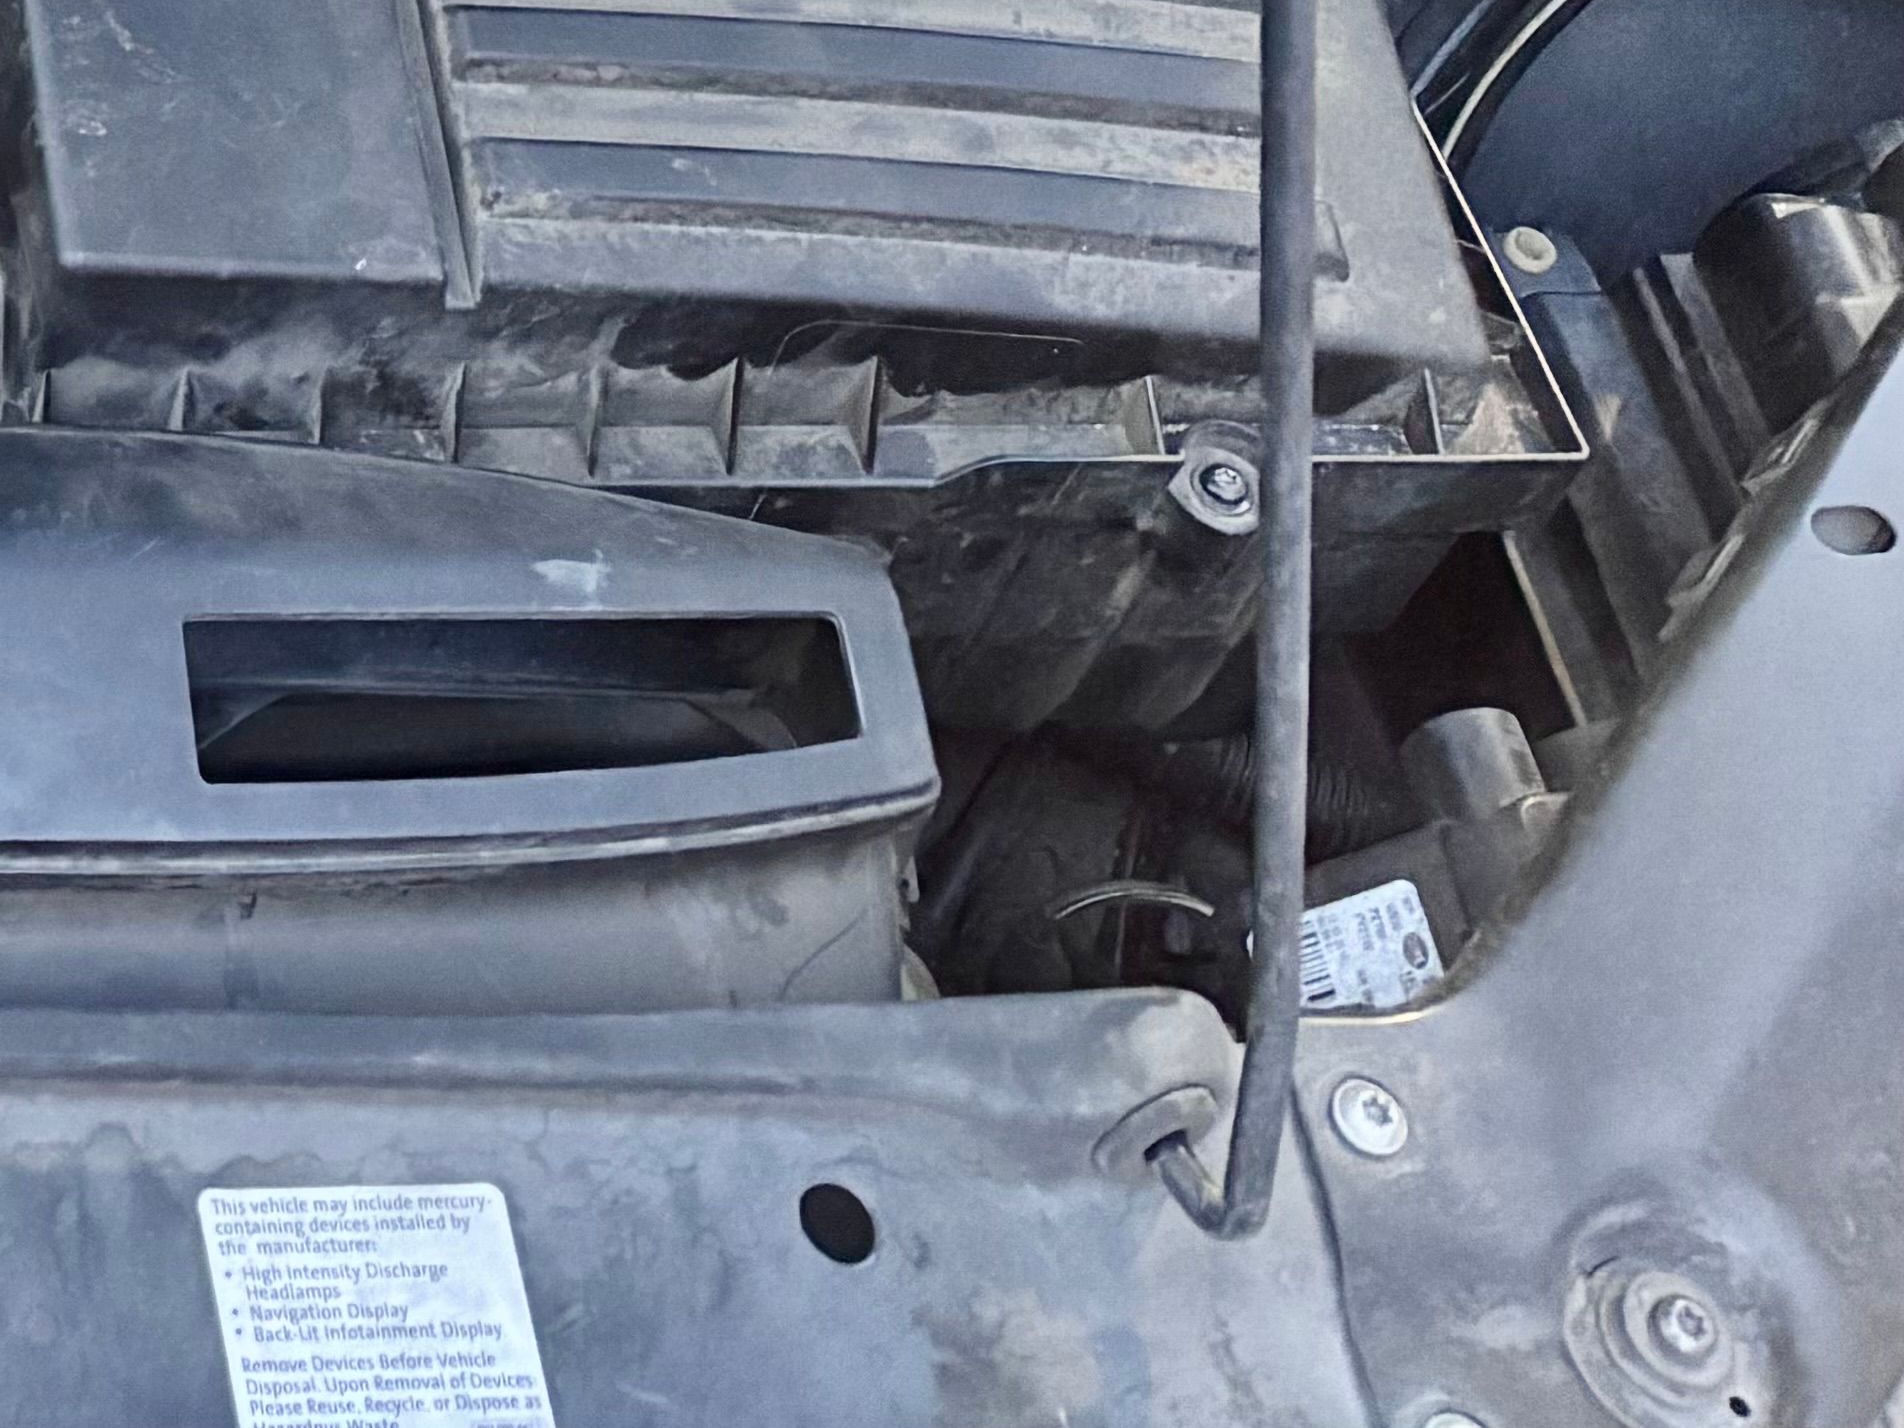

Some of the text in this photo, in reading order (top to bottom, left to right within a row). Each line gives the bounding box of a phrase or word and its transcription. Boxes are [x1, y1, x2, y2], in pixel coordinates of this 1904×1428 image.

[210, 1194, 492, 1217] This vehicle may include mercury-
[215, 1214, 470, 1238] containing devices installed by
[218, 1237, 378, 1256] the manufacturer:
[242, 1261, 448, 1286] High Intensity Discharge
[246, 1284, 342, 1303] Headlamps
[249, 1303, 408, 1326] Navigation Display
[254, 1321, 502, 1343] Back-Lit Infotainment Display
[242, 1351, 496, 1373] Remove Devices Before Vehicle
[324, 1378, 370, 1396] Upon
[374, 1374, 445, 1391] Removal
[450, 1371, 466, 1390] of
[250, 1398, 303, 1416] Please
[434, 1398, 450, 1411] or
[455, 1394, 520, 1415] Dispose
[524, 1396, 542, 1410] as
